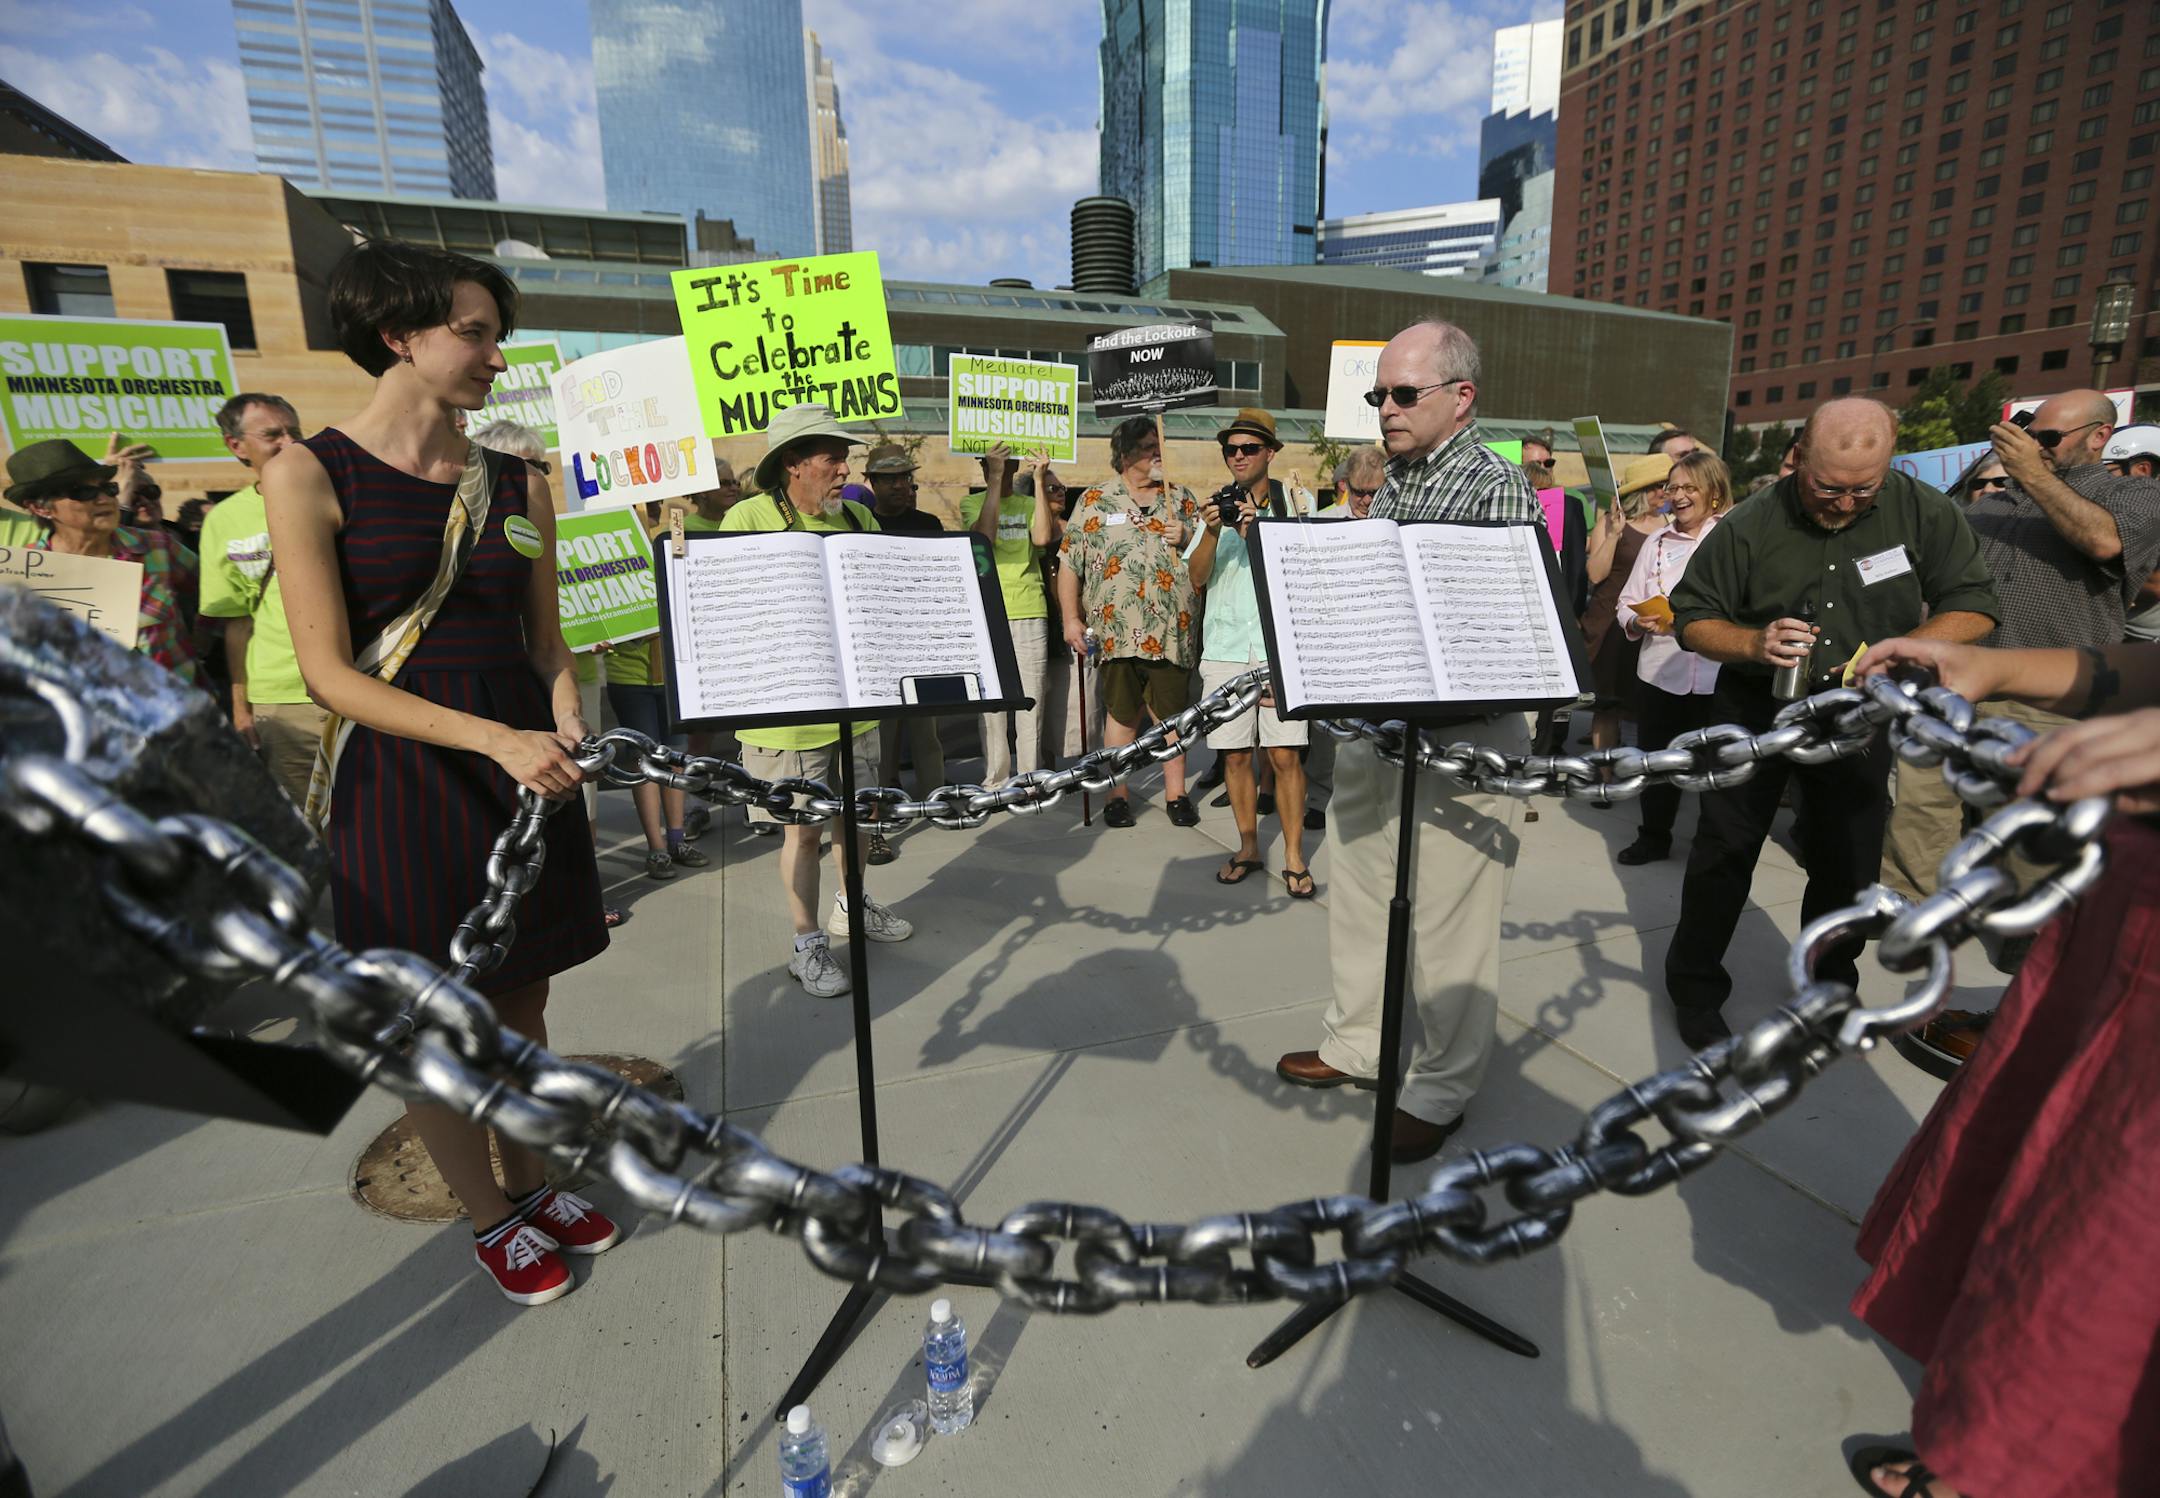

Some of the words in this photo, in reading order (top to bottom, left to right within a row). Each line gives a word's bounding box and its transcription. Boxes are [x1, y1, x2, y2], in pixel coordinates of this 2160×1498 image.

[690, 271, 761, 313] It's
[771, 264, 851, 297] Time
[761, 307, 794, 333] to
[1094, 336, 1118, 349] End
[1121, 332, 1142, 345] the
[1145, 325, 1197, 342] Lockout
[0, 341, 216, 379] SUPPORT
[710, 321, 872, 381] Celebrate
[1130, 347, 1165, 363] NOW
[781, 370, 813, 388] the
[970, 356, 1053, 377] Mediate!
[7, 376, 119, 395] MINNESOTA
[121, 378, 225, 396] ORCHESTRA
[560, 369, 623, 421] END
[958, 372, 1071, 404] SUPPORT
[587, 396, 669, 437] THE
[958, 395, 1013, 411] MINNESOTA
[1015, 400, 1069, 416] ORCHESTRA
[957, 408, 1070, 440] MUSICIANS
[963, 439, 989, 454] NOT
[572, 436, 697, 500] LOCKOUT
[575, 556, 649, 582] ORCHESTRA
